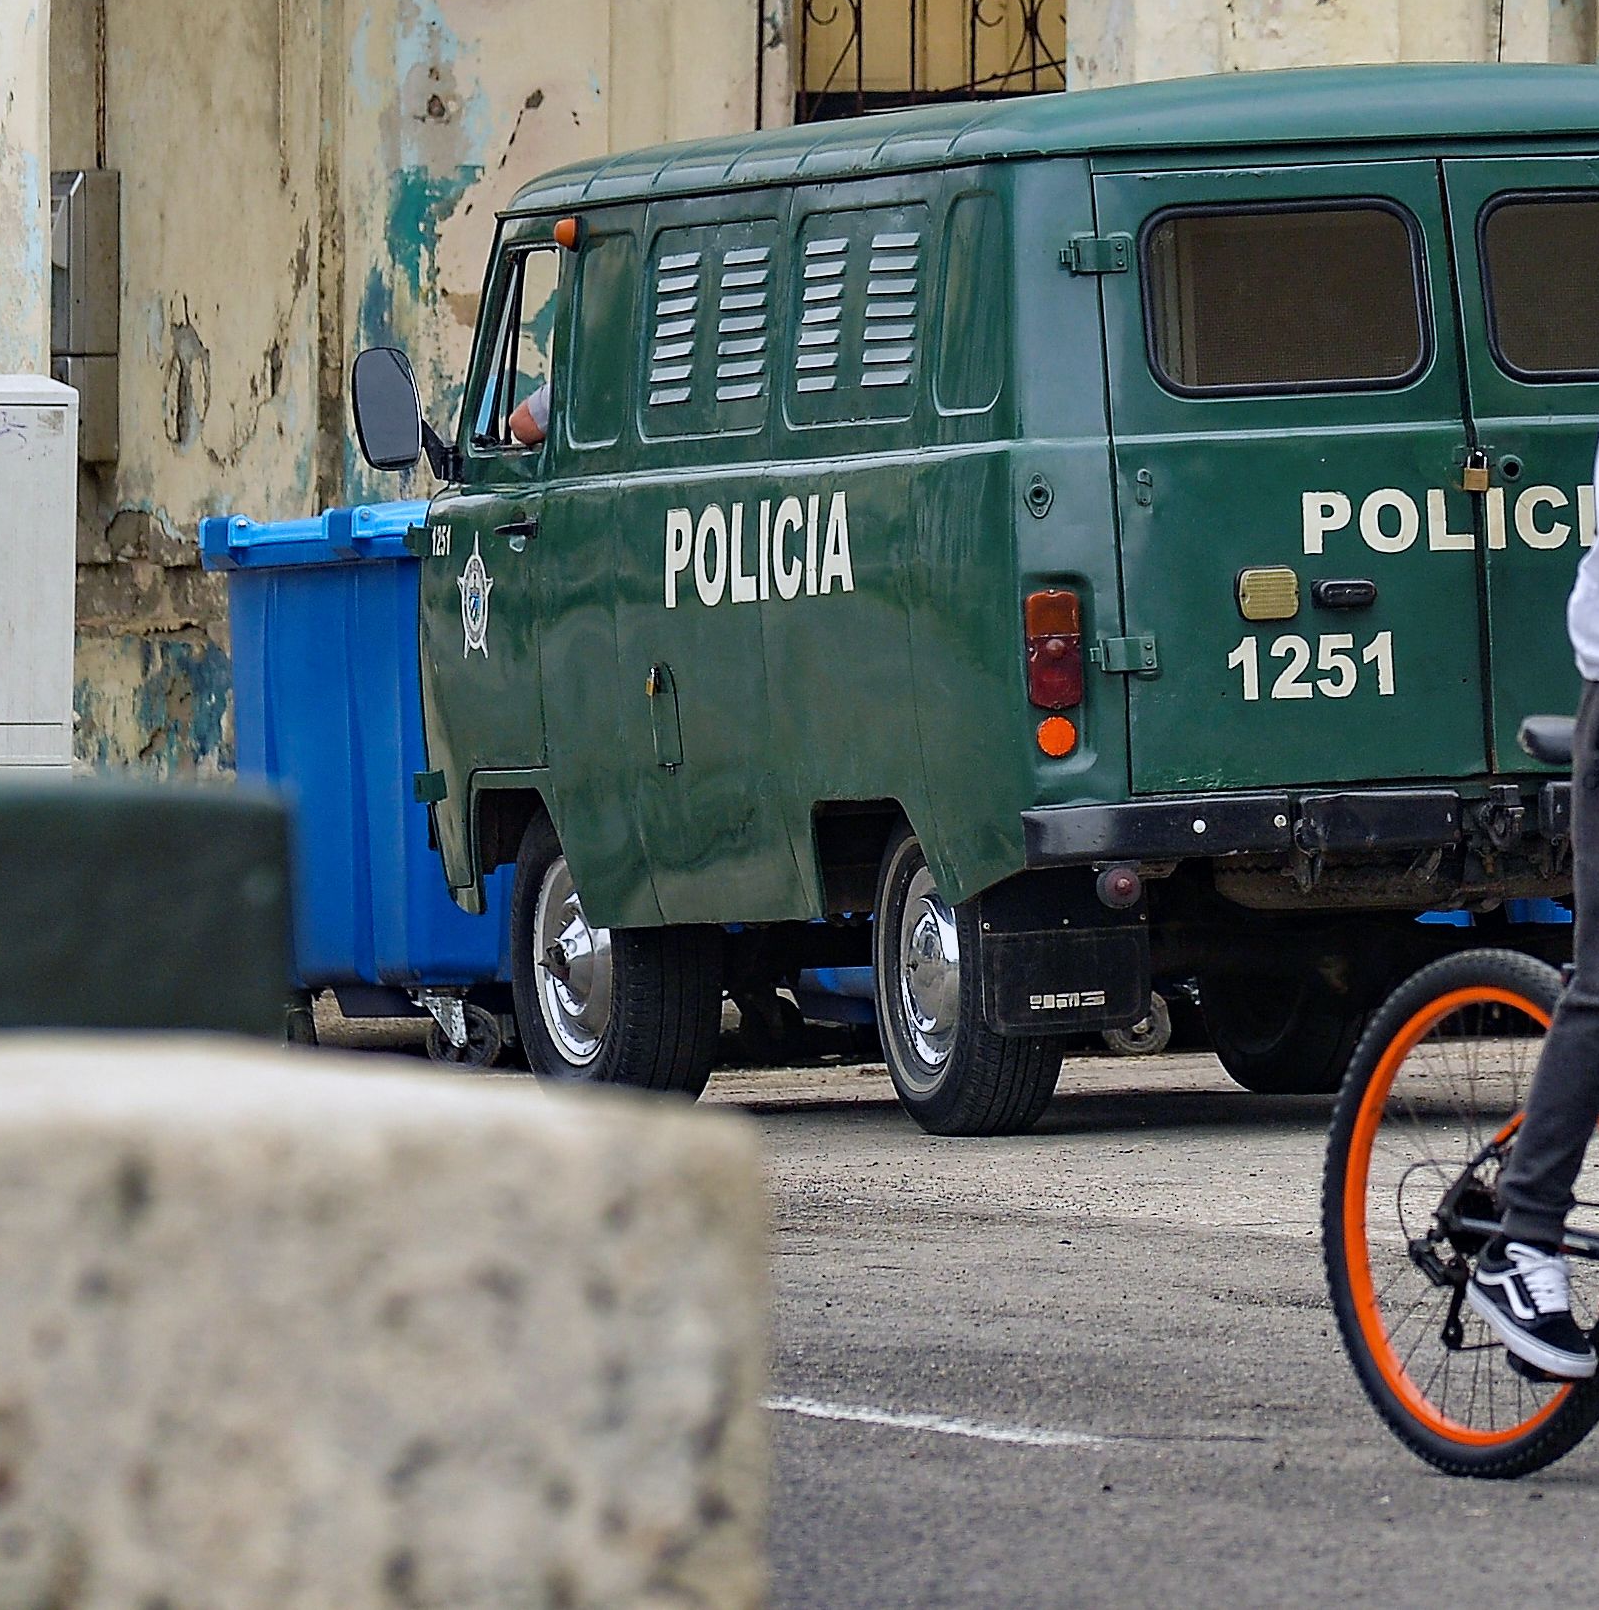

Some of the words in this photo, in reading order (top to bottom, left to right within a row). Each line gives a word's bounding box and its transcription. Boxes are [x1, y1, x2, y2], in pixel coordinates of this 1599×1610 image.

[432, 524, 452, 557] 1251
[664, 491, 854, 609] POLICIA
[1302, 484, 1599, 555] POLICI
[1227, 630, 1395, 701] 1251
